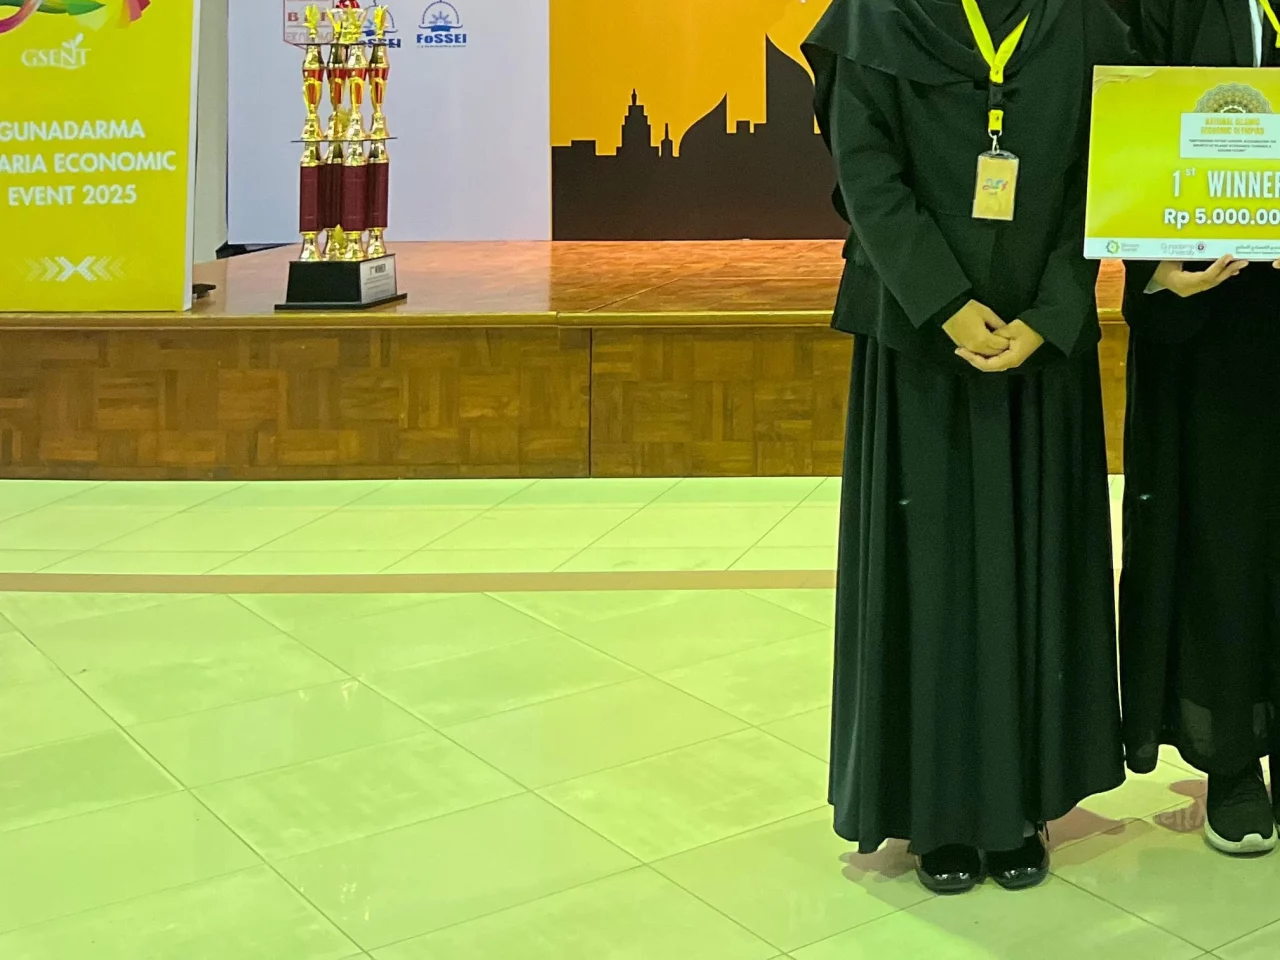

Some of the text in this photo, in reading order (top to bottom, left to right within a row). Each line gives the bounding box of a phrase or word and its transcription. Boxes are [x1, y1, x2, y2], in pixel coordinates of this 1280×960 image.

[416, 34, 467, 44] FoSSEI
[21, 40, 91, 70] GSENT
[0, 119, 146, 141] GUNADARMA
[54, 150, 177, 173] ECONOMIC
[8, 184, 137, 206] EVENT 2025
[1164, 208, 1190, 229] Rp
